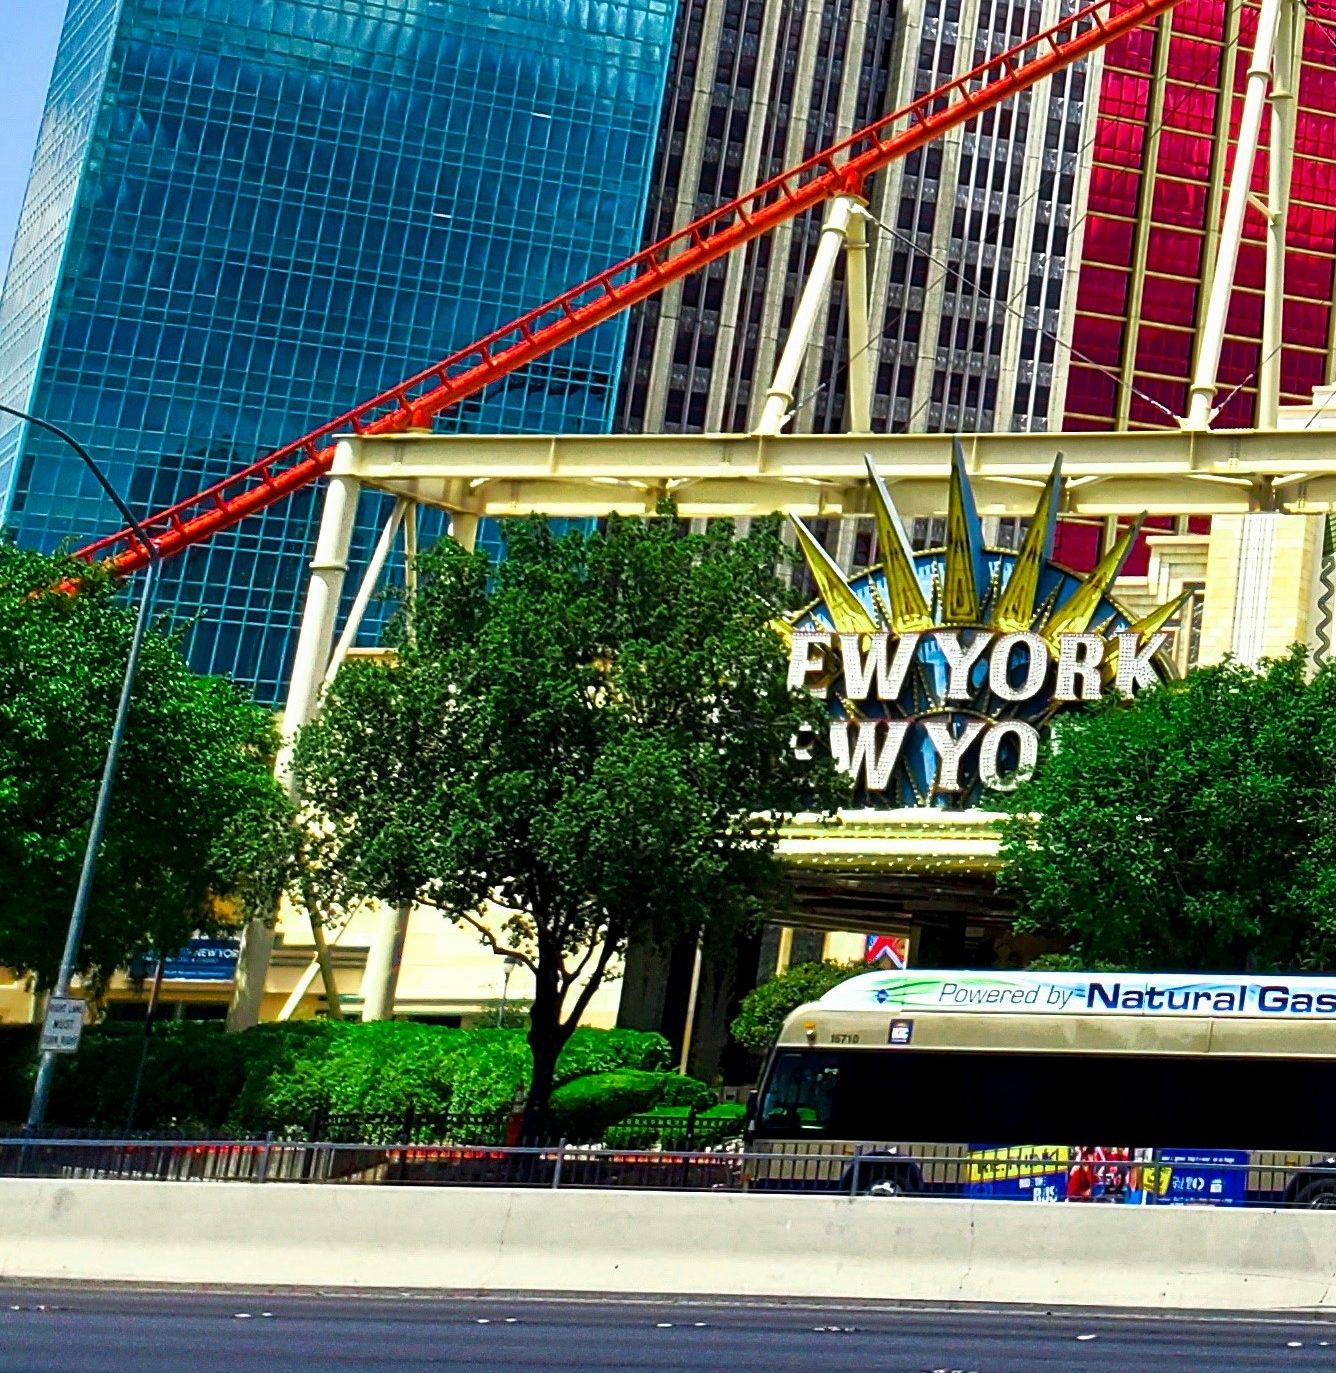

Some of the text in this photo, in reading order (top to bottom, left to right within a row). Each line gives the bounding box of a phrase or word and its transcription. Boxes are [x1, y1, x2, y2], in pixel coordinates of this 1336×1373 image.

[787, 631, 1168, 701] EW YORK
[923, 719, 1062, 792] YO
[939, 983, 1041, 1004] Powered
[1047, 985, 1074, 1010] by
[1087, 982, 1248, 1012] Natural
